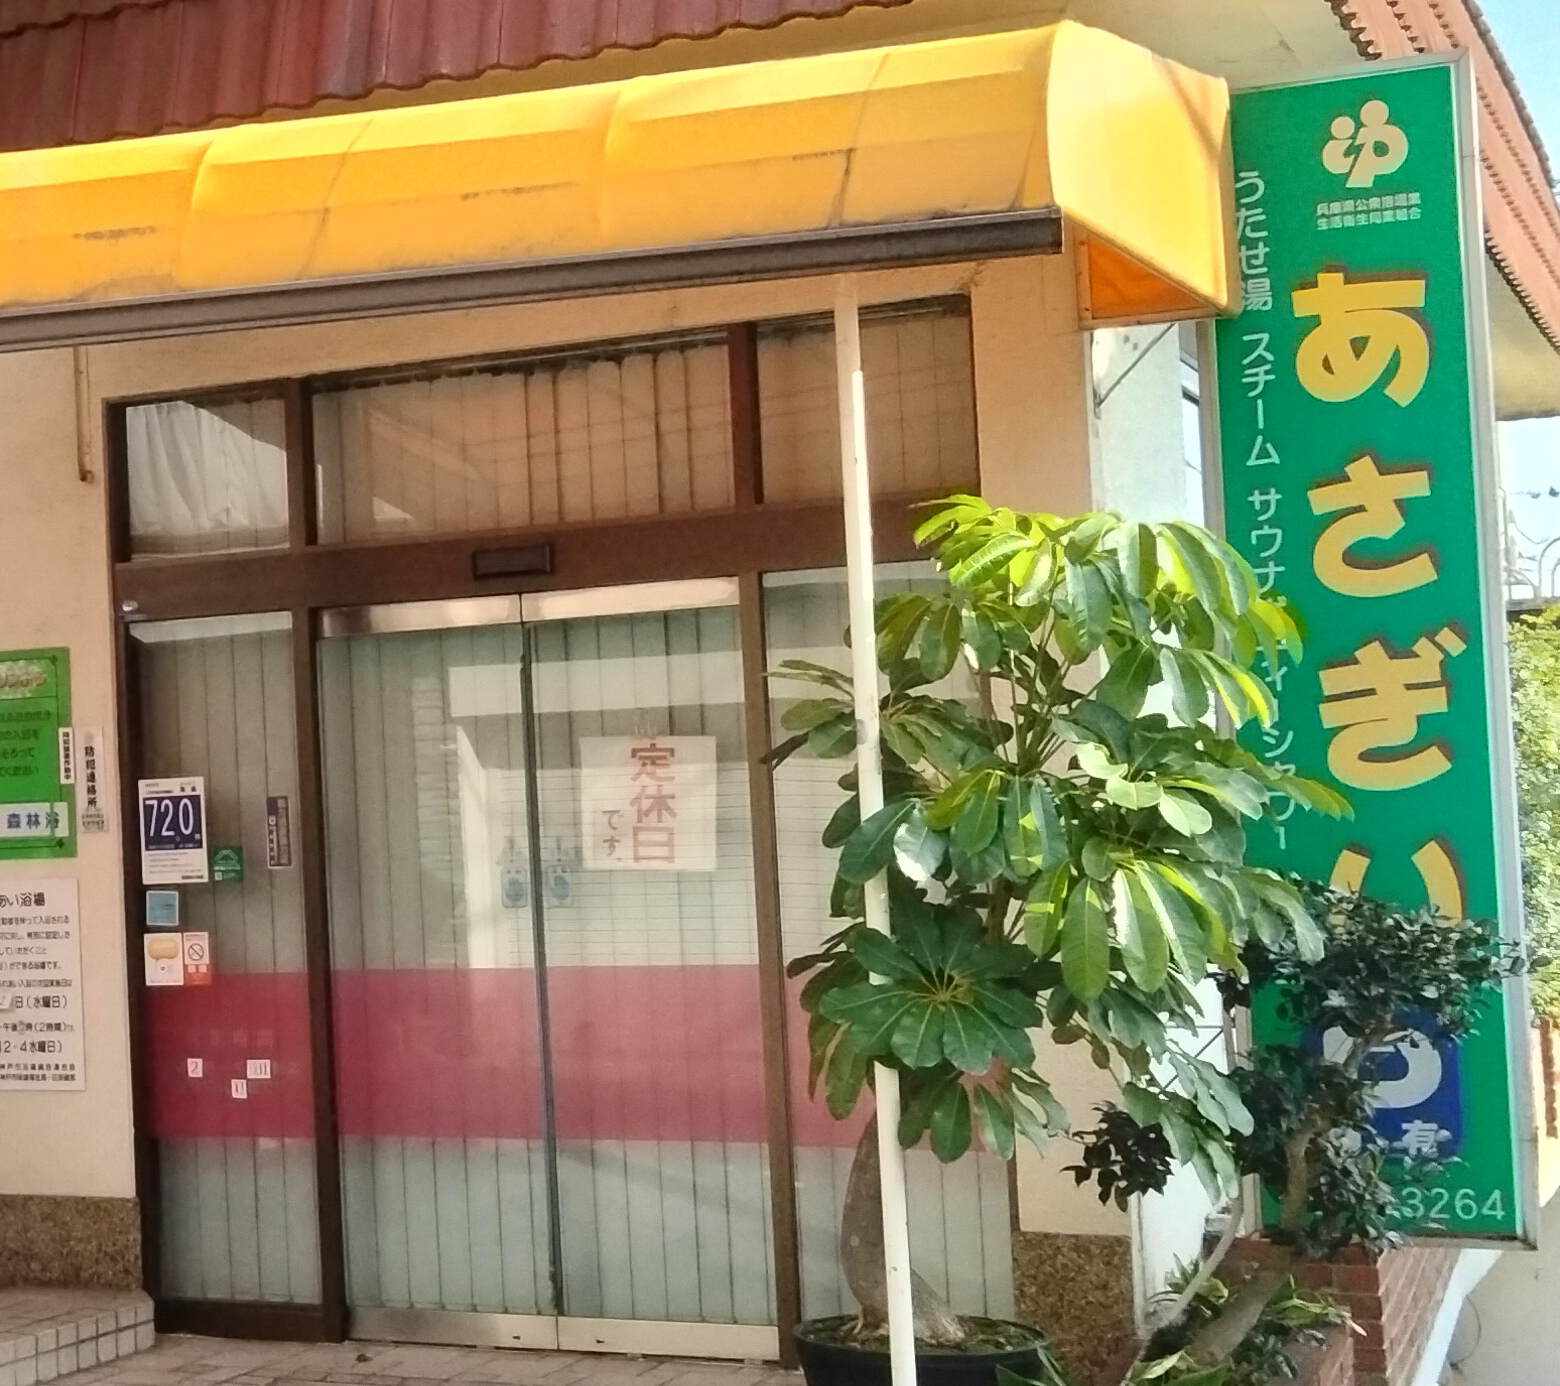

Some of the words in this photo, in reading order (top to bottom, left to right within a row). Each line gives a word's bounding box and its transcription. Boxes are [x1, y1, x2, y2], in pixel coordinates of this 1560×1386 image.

[1236, 170, 1273, 311] うたせ湯
[1241, 331, 1281, 467] スチーム
[629, 742, 678, 864] 定休日
